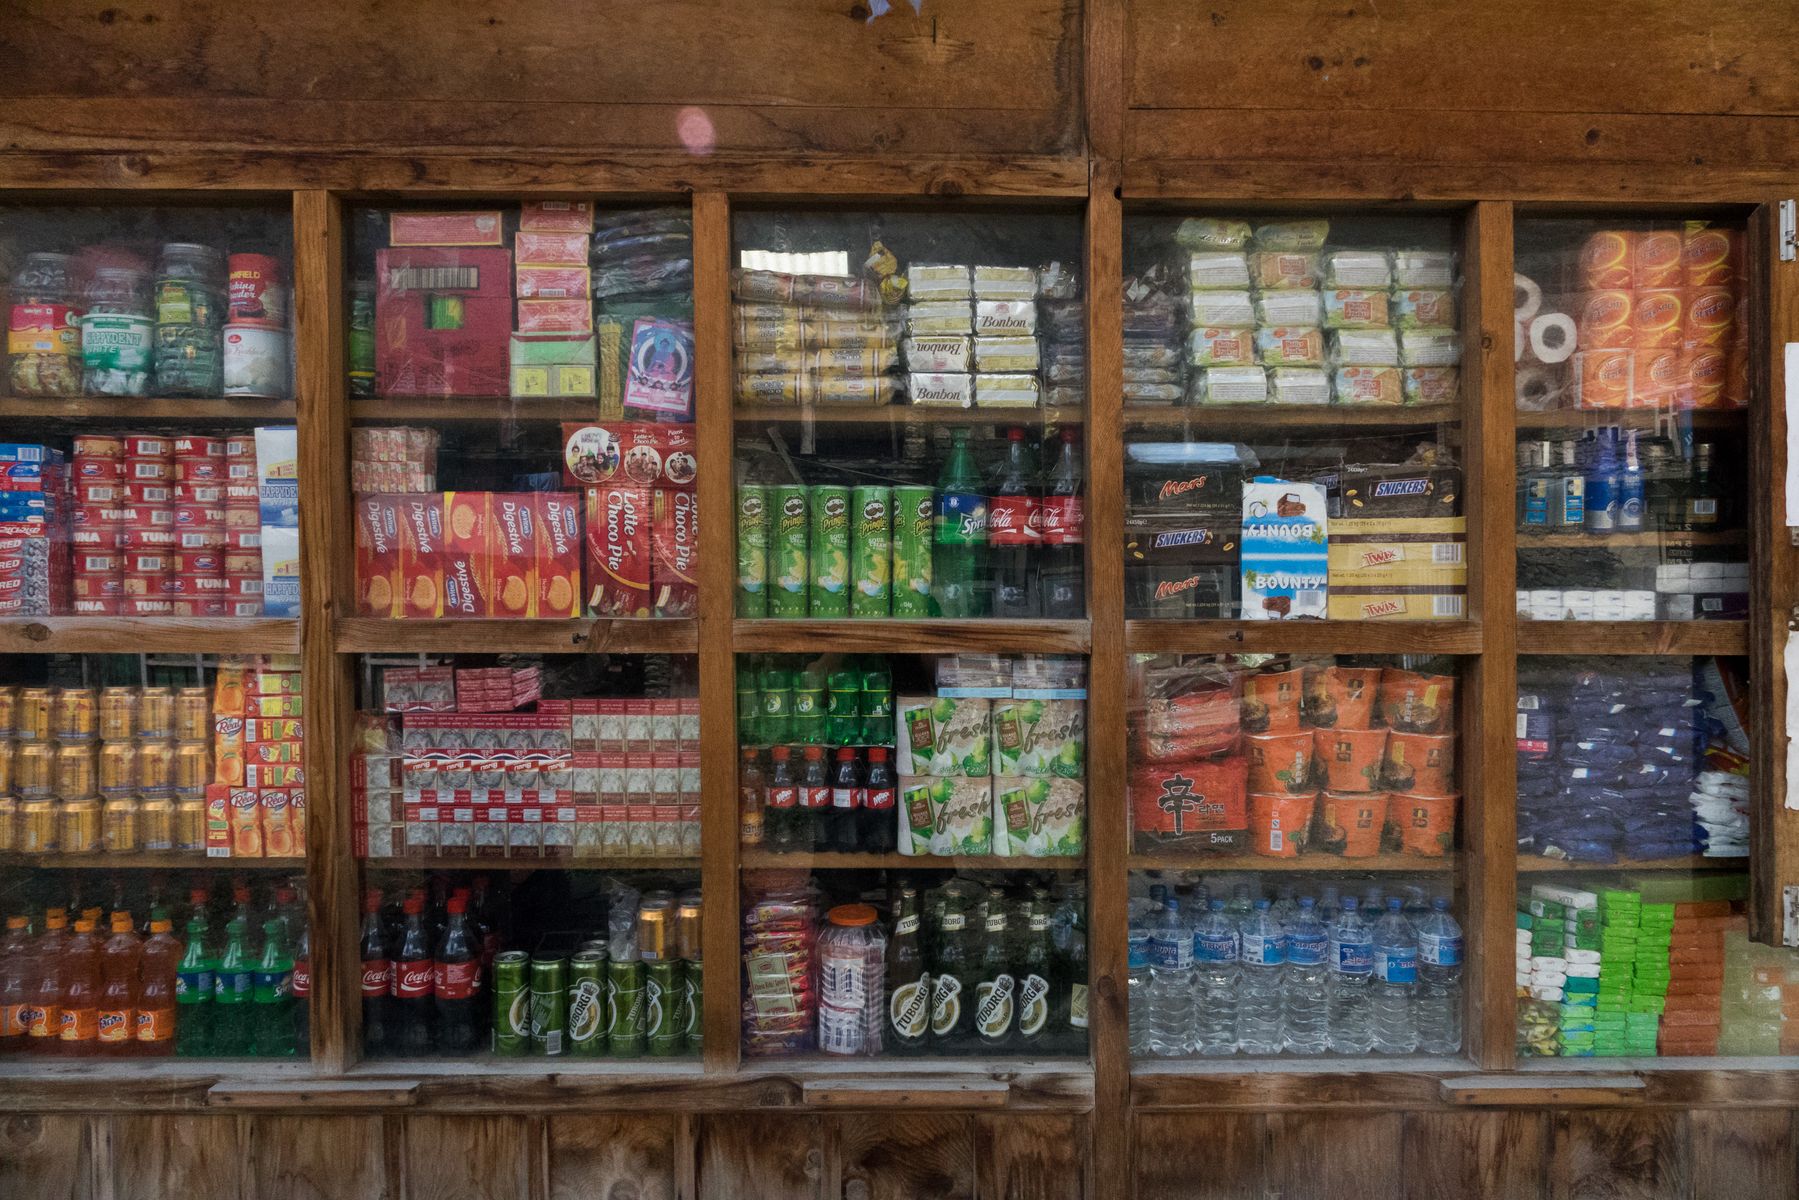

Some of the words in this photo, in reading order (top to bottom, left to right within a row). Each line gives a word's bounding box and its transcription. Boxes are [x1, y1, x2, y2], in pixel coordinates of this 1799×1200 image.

[981, 316, 1028, 330] Bonbon
[917, 342, 961, 356] Bonbon
[917, 386, 961, 401] Bonbon
[1159, 475, 1208, 500] Mars
[1377, 480, 1426, 495] SNICKERS
[367, 502, 388, 554] Digestive
[411, 502, 432, 554] Digestive
[548, 502, 569, 554] Digestive
[607, 491, 623, 541] Choco
[624, 492, 639, 536] Lotte
[674, 492, 690, 542] Choco
[962, 518, 986, 535] Spri
[503, 502, 523, 555] Digestive
[1157, 530, 1206, 546] SNICKERS
[1247, 524, 1313, 537] BOUNTY
[608, 542, 622, 571] Pie
[675, 543, 690, 571] Pie
[1363, 550, 1396, 566] Twix
[455, 561, 475, 613] Digestive
[1155, 575, 1201, 600] Mars
[1255, 576, 1322, 589] BOUNTY
[1366, 601, 1397, 616] Twix
[220, 718, 242, 732] Real
[937, 713, 990, 754] fresh
[1024, 713, 1085, 754] fresh
[235, 791, 257, 807] Real
[265, 791, 288, 807] Real
[1157, 773, 1205, 836] 辛
[937, 792, 991, 835] fresh
[1033, 793, 1084, 835] fresh
[896, 986, 928, 1031] TUBORG
[977, 986, 1006, 1028] TUBORG
[1021, 986, 1036, 1010] ORG
[570, 993, 592, 1033] TUBORG
